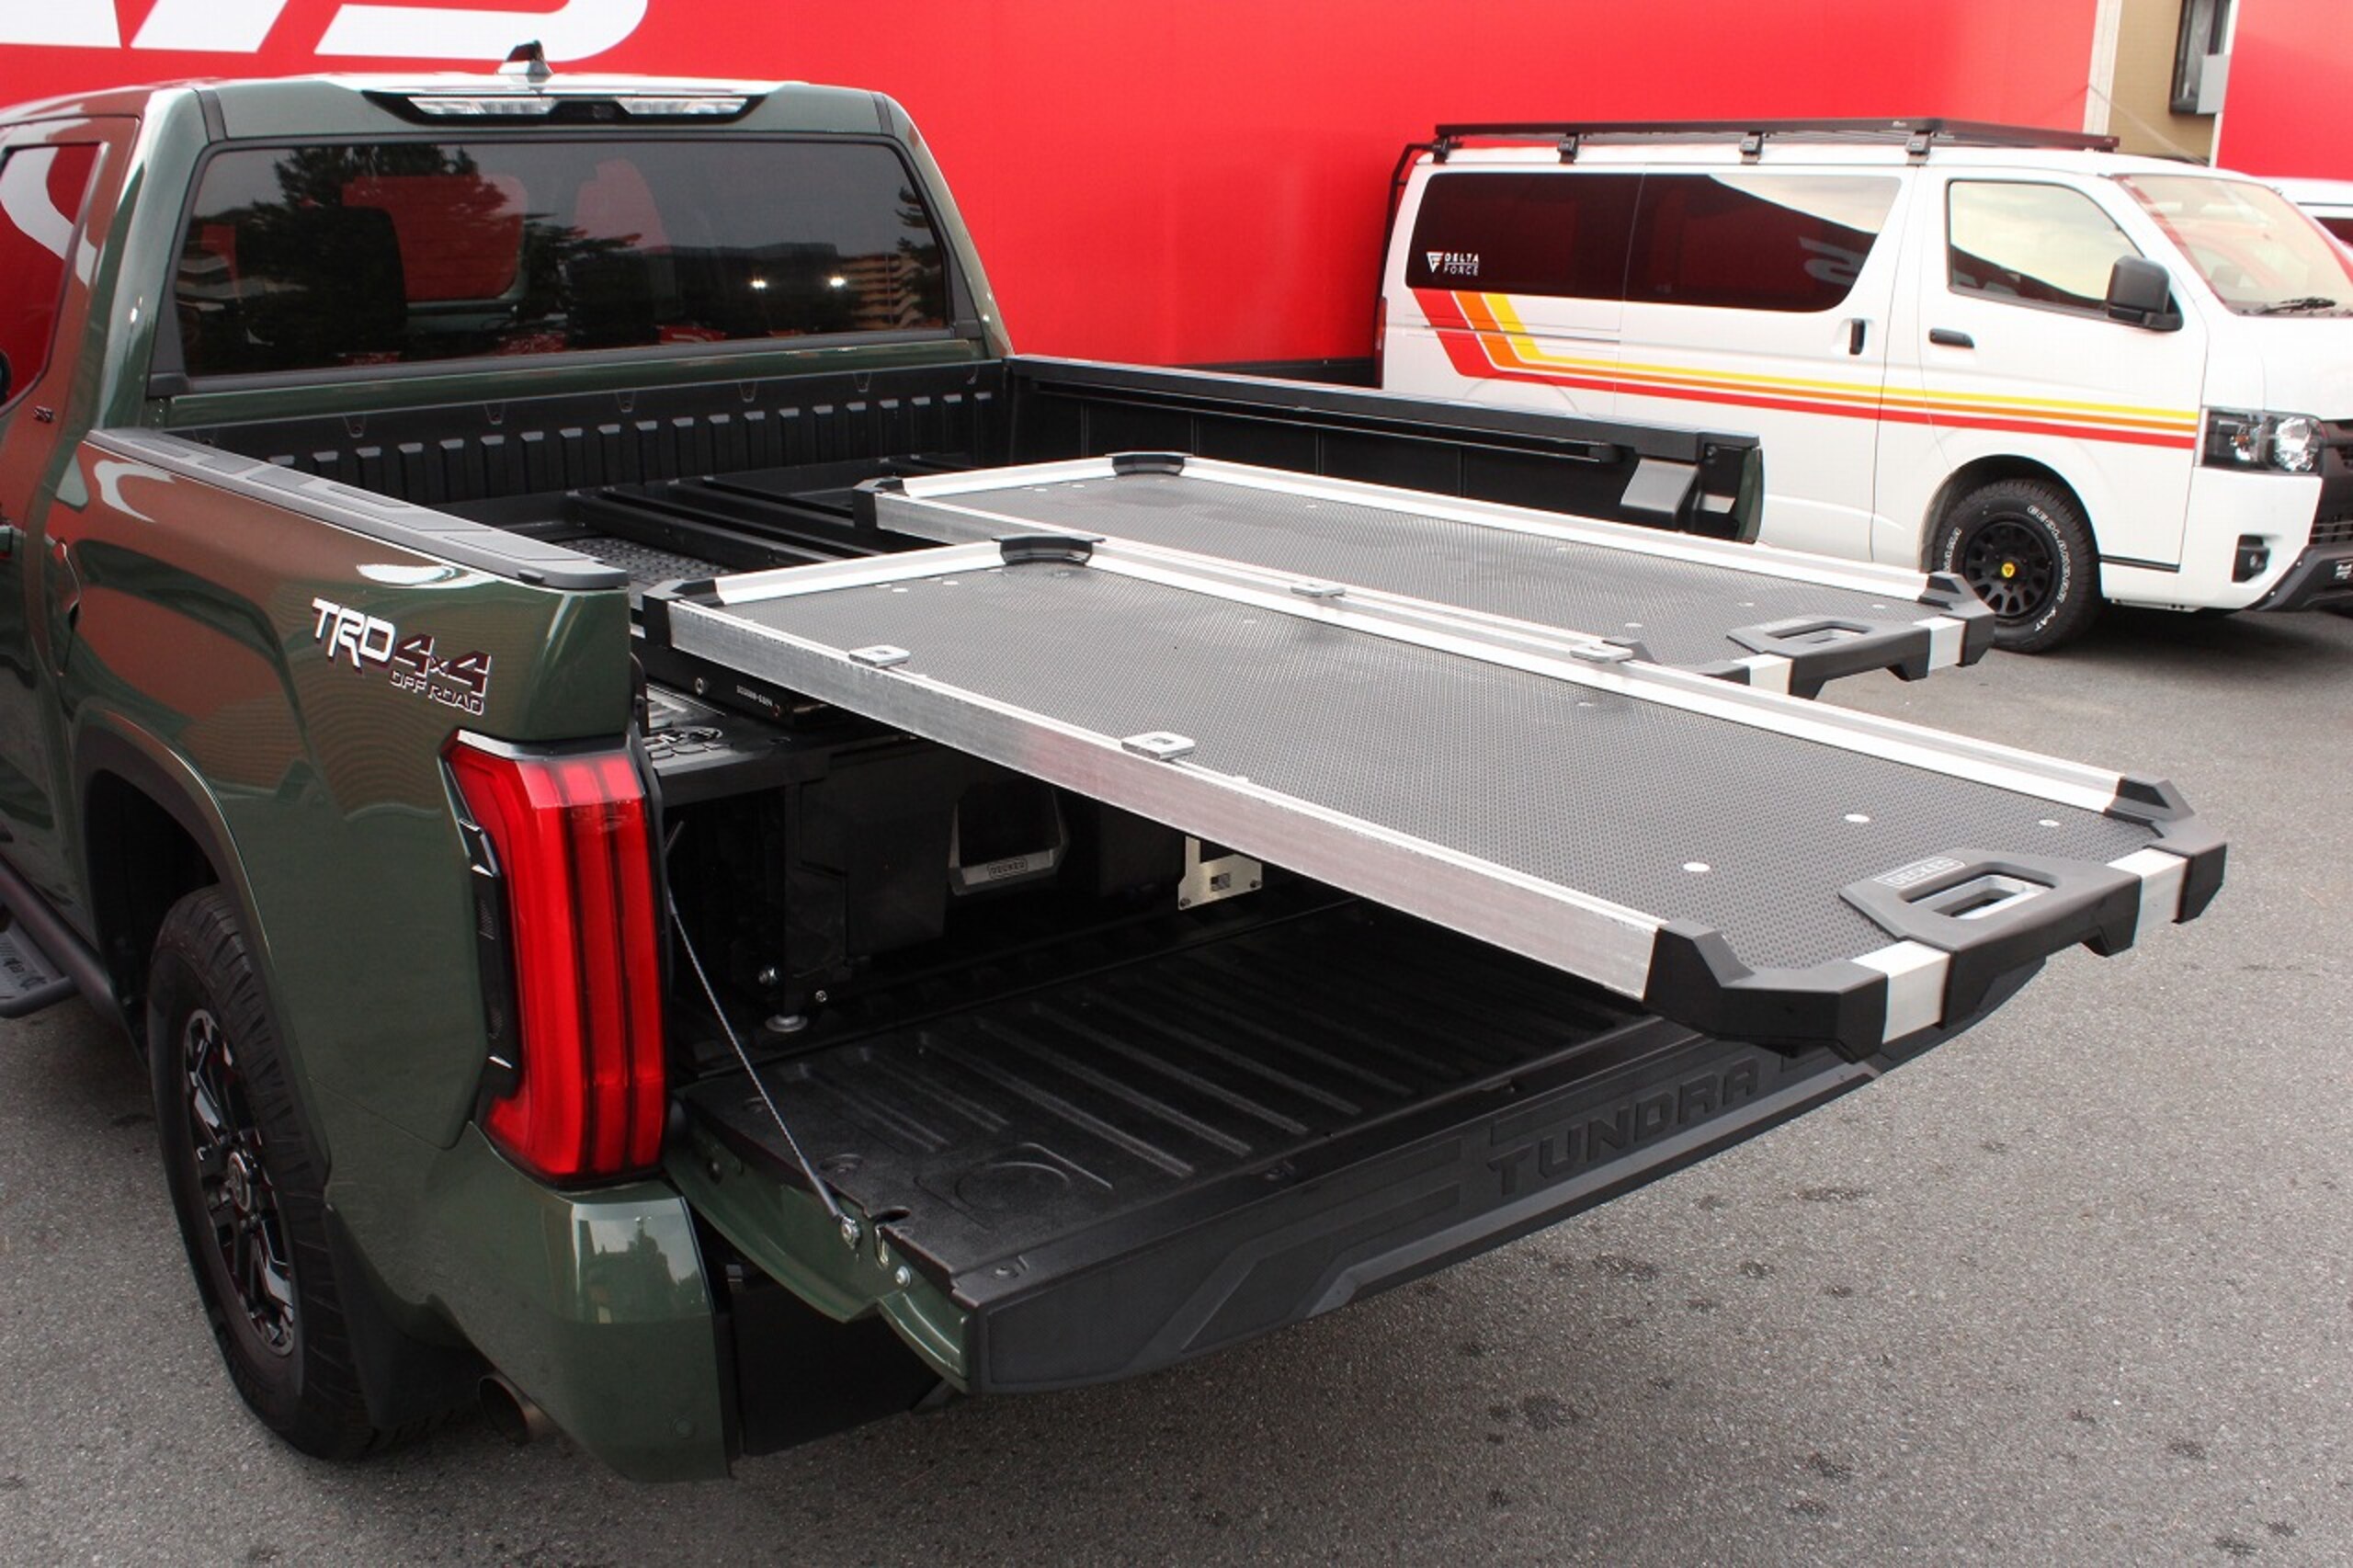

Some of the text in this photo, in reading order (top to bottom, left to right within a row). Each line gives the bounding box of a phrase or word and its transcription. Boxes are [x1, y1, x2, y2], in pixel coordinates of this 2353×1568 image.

[1443, 264, 1479, 276] FORCE
[1444, 252, 1479, 263] DELTA
[312, 597, 397, 674] TRD
[390, 670, 485, 716] OFF ROAD
[1486, 1056, 1760, 1198] TUNDRA
